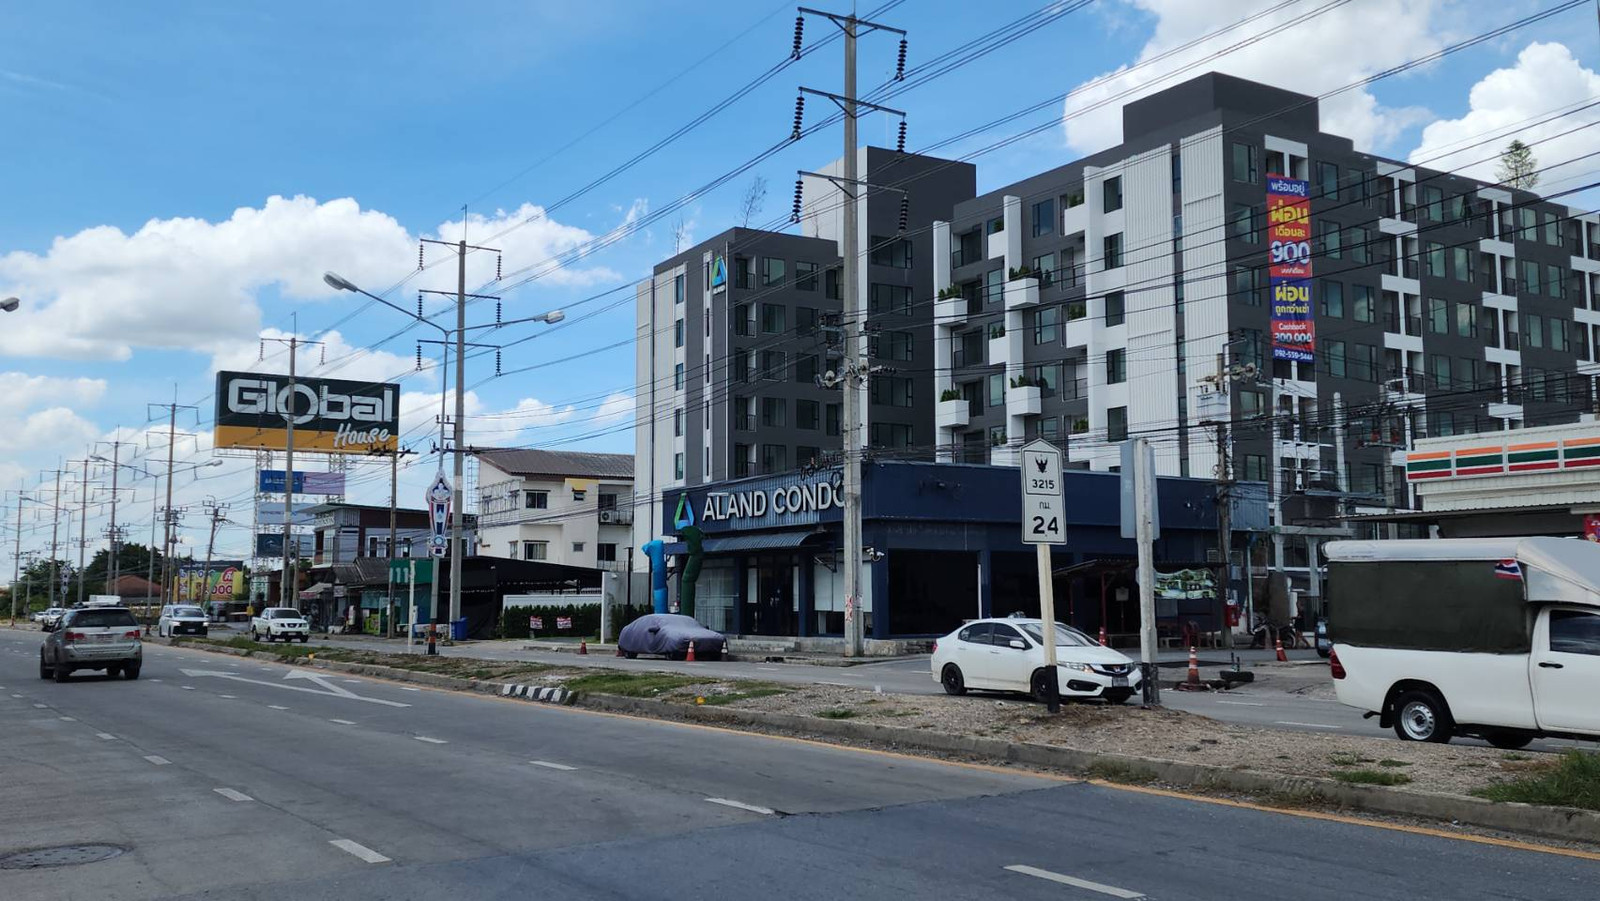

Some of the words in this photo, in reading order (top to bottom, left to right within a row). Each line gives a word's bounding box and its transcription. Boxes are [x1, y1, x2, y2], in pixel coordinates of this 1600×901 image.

[1271, 199, 1309, 225] ผ่อน
[1271, 240, 1311, 265] 900
[1275, 280, 1310, 302] ผ่อน
[227, 378, 393, 425] Global
[334, 423, 391, 447] House
[1031, 479, 1055, 490] 3215
[702, 490, 768, 521] ALAND
[773, 480, 845, 514] CONDO
[1032, 515, 1059, 535] 24
